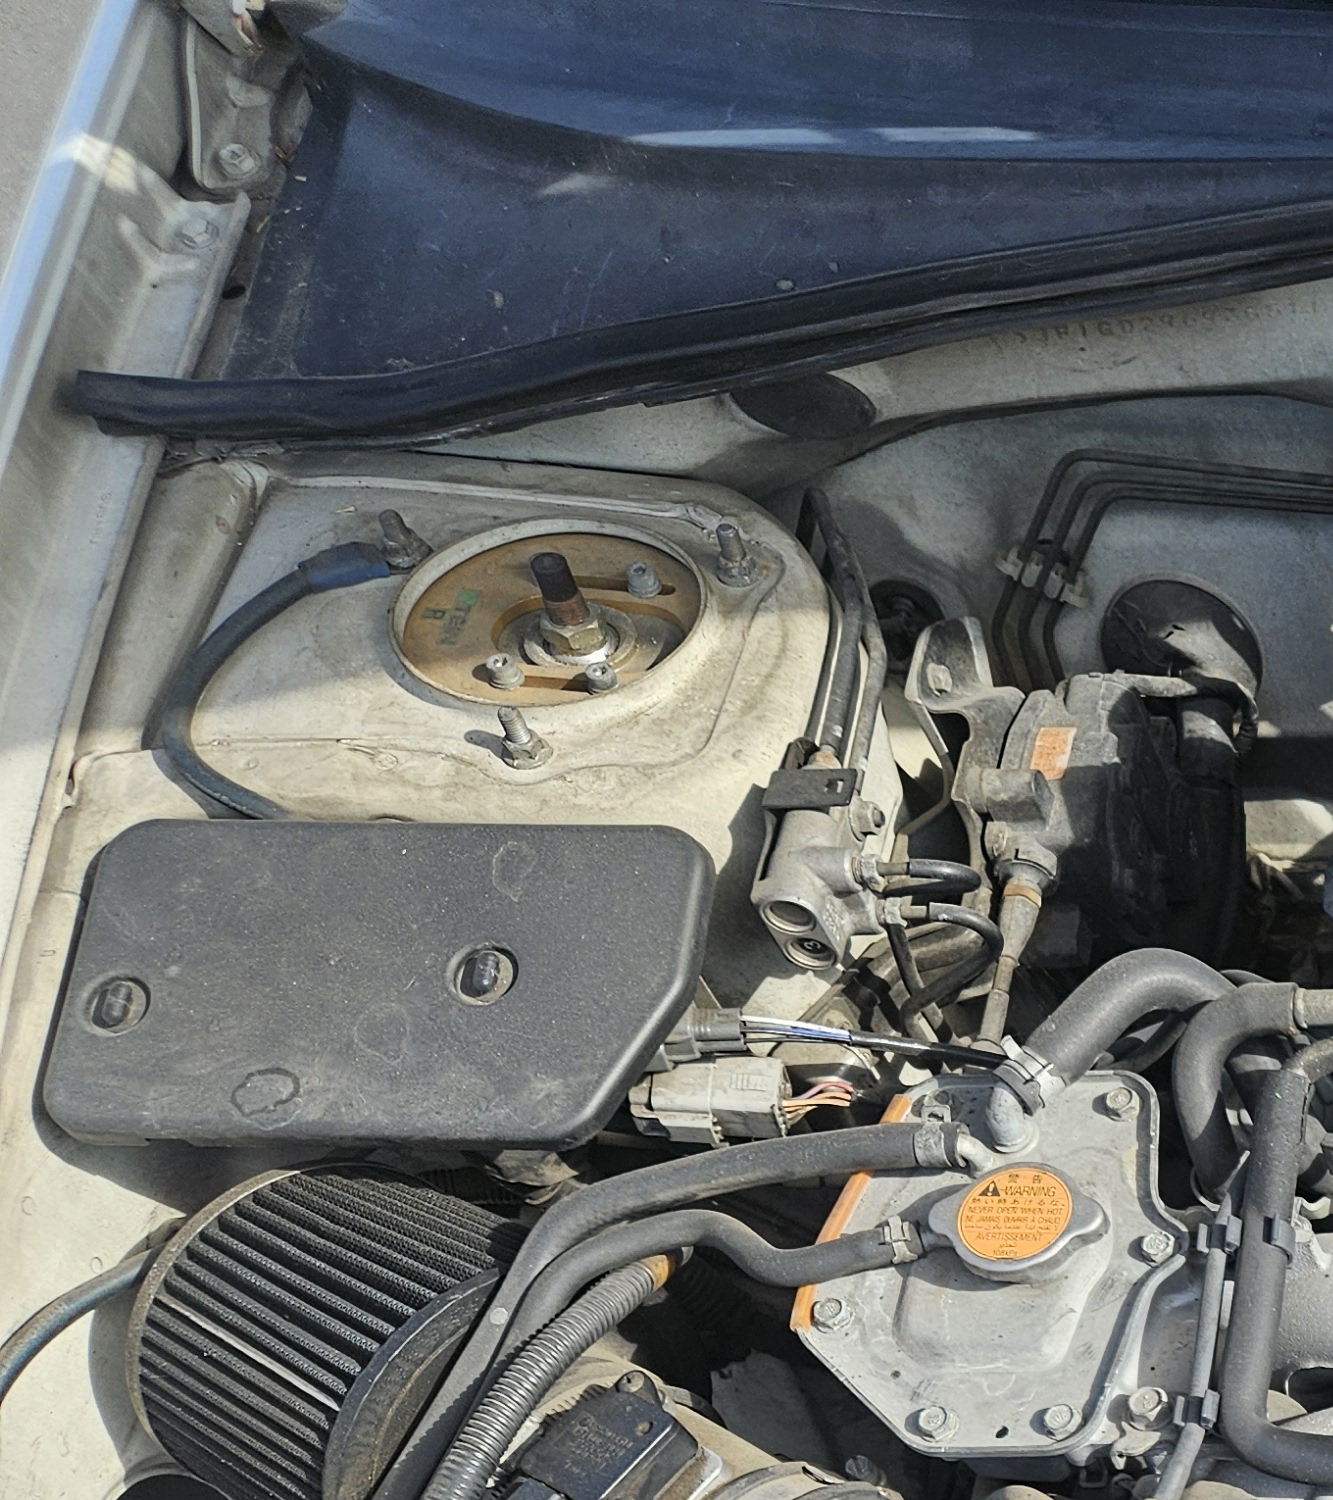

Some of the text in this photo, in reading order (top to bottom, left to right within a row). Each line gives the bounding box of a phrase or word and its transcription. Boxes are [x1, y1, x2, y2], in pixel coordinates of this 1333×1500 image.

[1004, 1186, 1057, 1197] WARNING
[968, 1206, 993, 1214] NEVER
[975, 1232, 1042, 1242] AVERTISSEMENT
